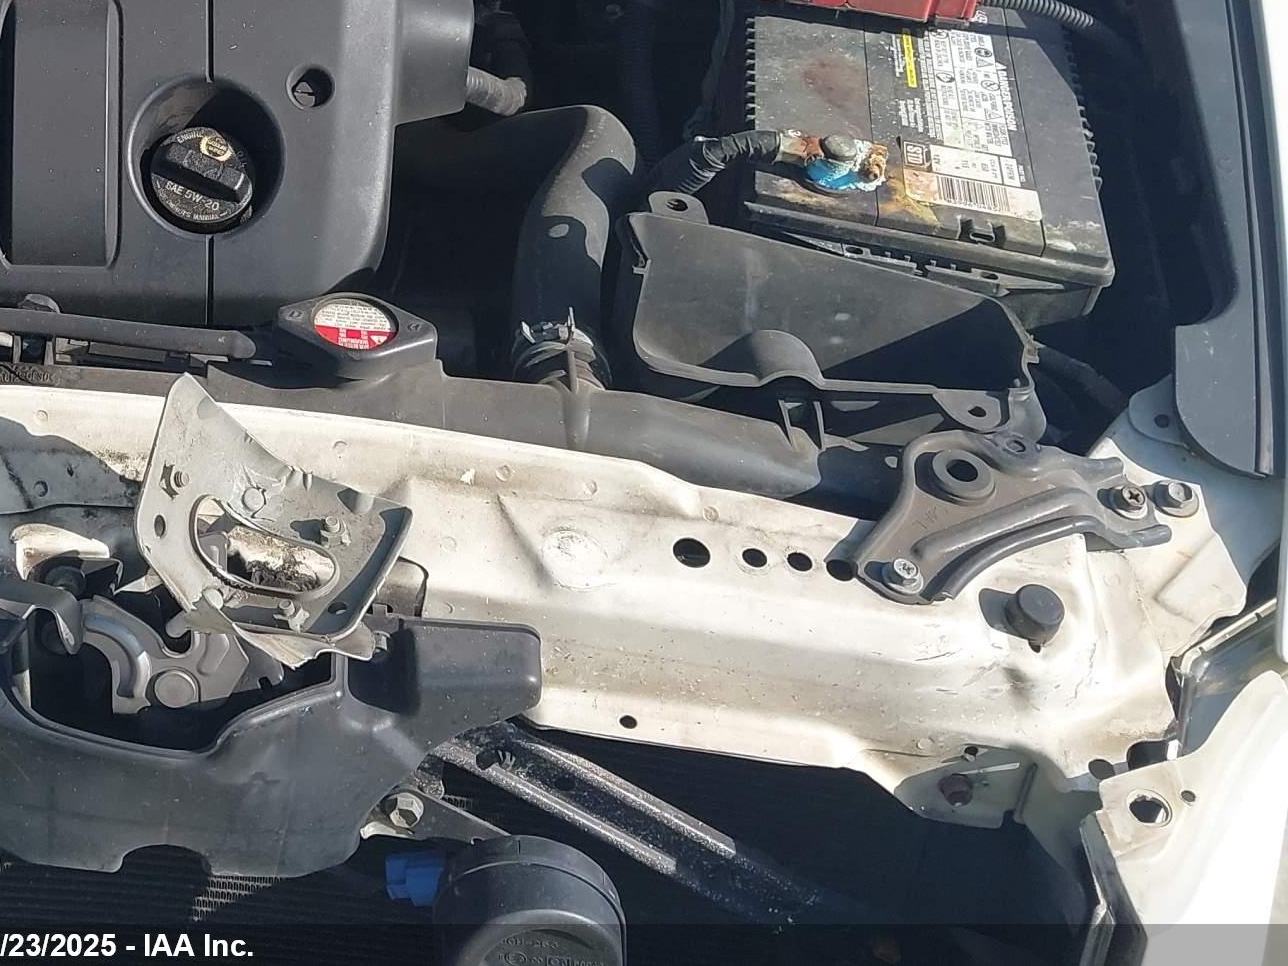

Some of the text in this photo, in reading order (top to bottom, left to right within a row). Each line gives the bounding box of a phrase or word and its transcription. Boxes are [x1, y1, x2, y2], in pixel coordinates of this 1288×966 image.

[1003, 101, 1018, 131] POISON
[165, 180, 184, 196] SAE
[184, 189, 220, 211] 5W-20
